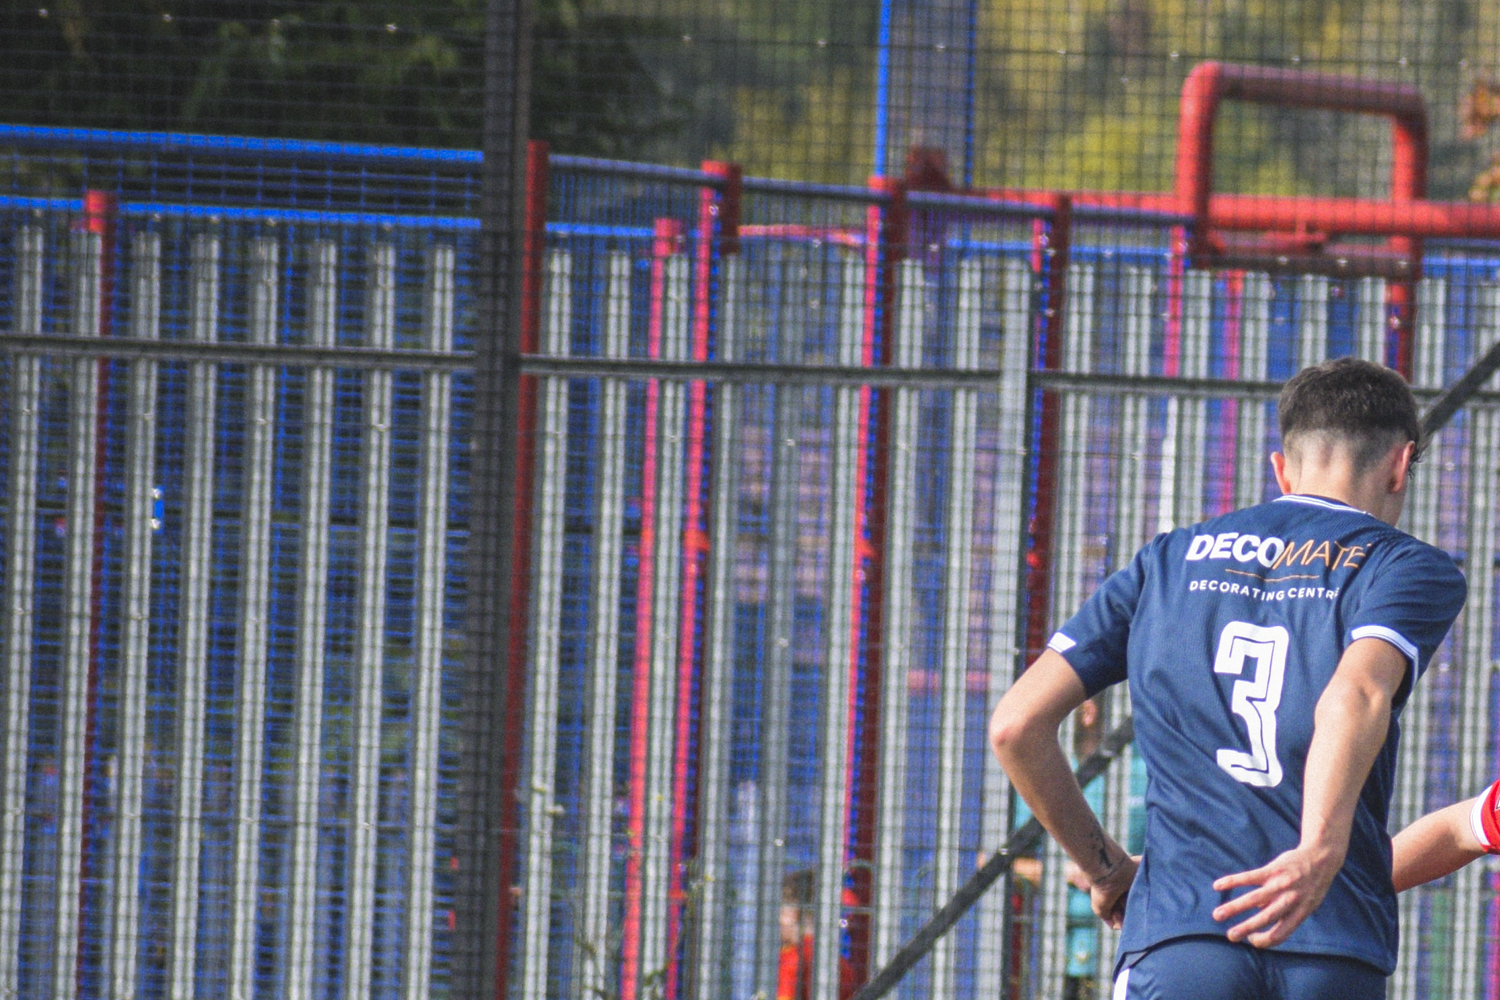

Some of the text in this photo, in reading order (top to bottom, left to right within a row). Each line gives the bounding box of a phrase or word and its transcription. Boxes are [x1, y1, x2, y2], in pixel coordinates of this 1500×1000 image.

[1186, 532, 1368, 570] DECOMATE
[1189, 580, 1285, 601] DECORATING
[1214, 620, 1290, 788] 3
